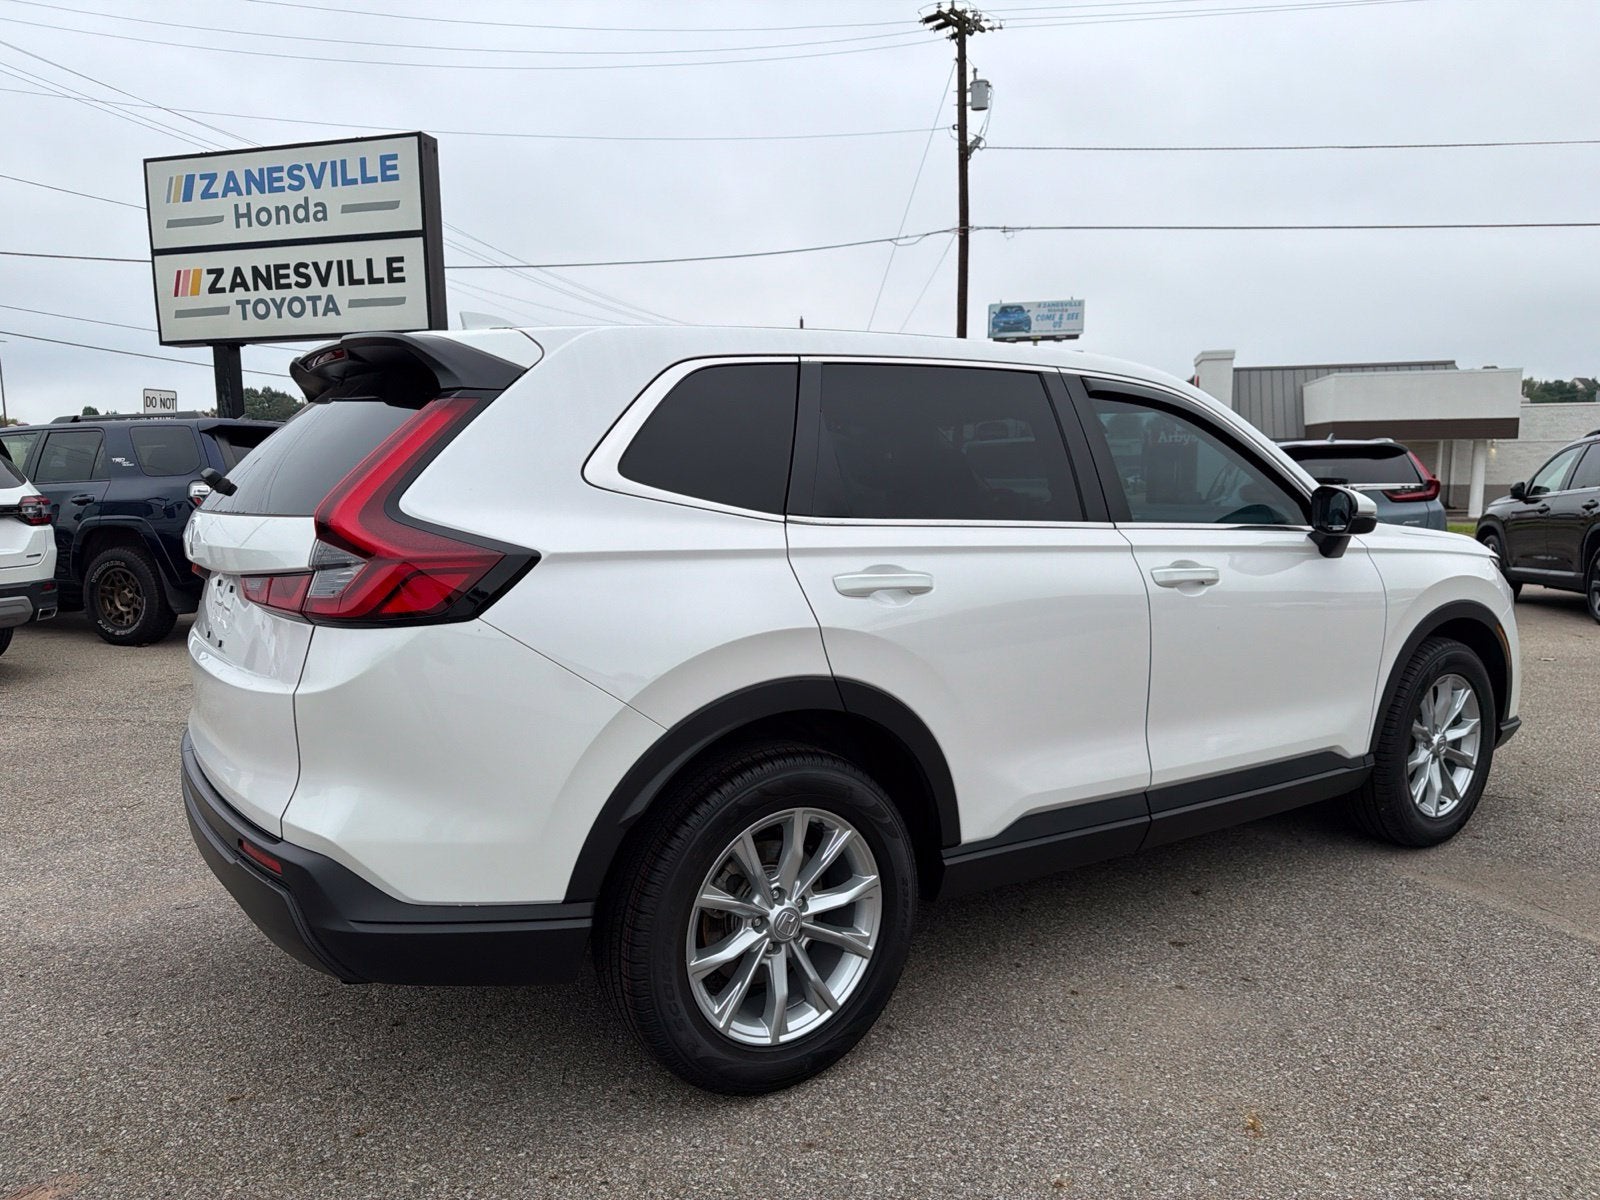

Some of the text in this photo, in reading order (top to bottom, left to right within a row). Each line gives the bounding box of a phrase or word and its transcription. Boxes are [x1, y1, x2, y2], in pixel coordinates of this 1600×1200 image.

[199, 153, 401, 200] ZANESVILLE
[233, 196, 328, 229] Honda
[206, 256, 407, 295] ZANESVILLE
[235, 294, 341, 321] TOYOTA
[1067, 312, 1079, 320] SEE
[145, 396, 175, 410] DO NOT
